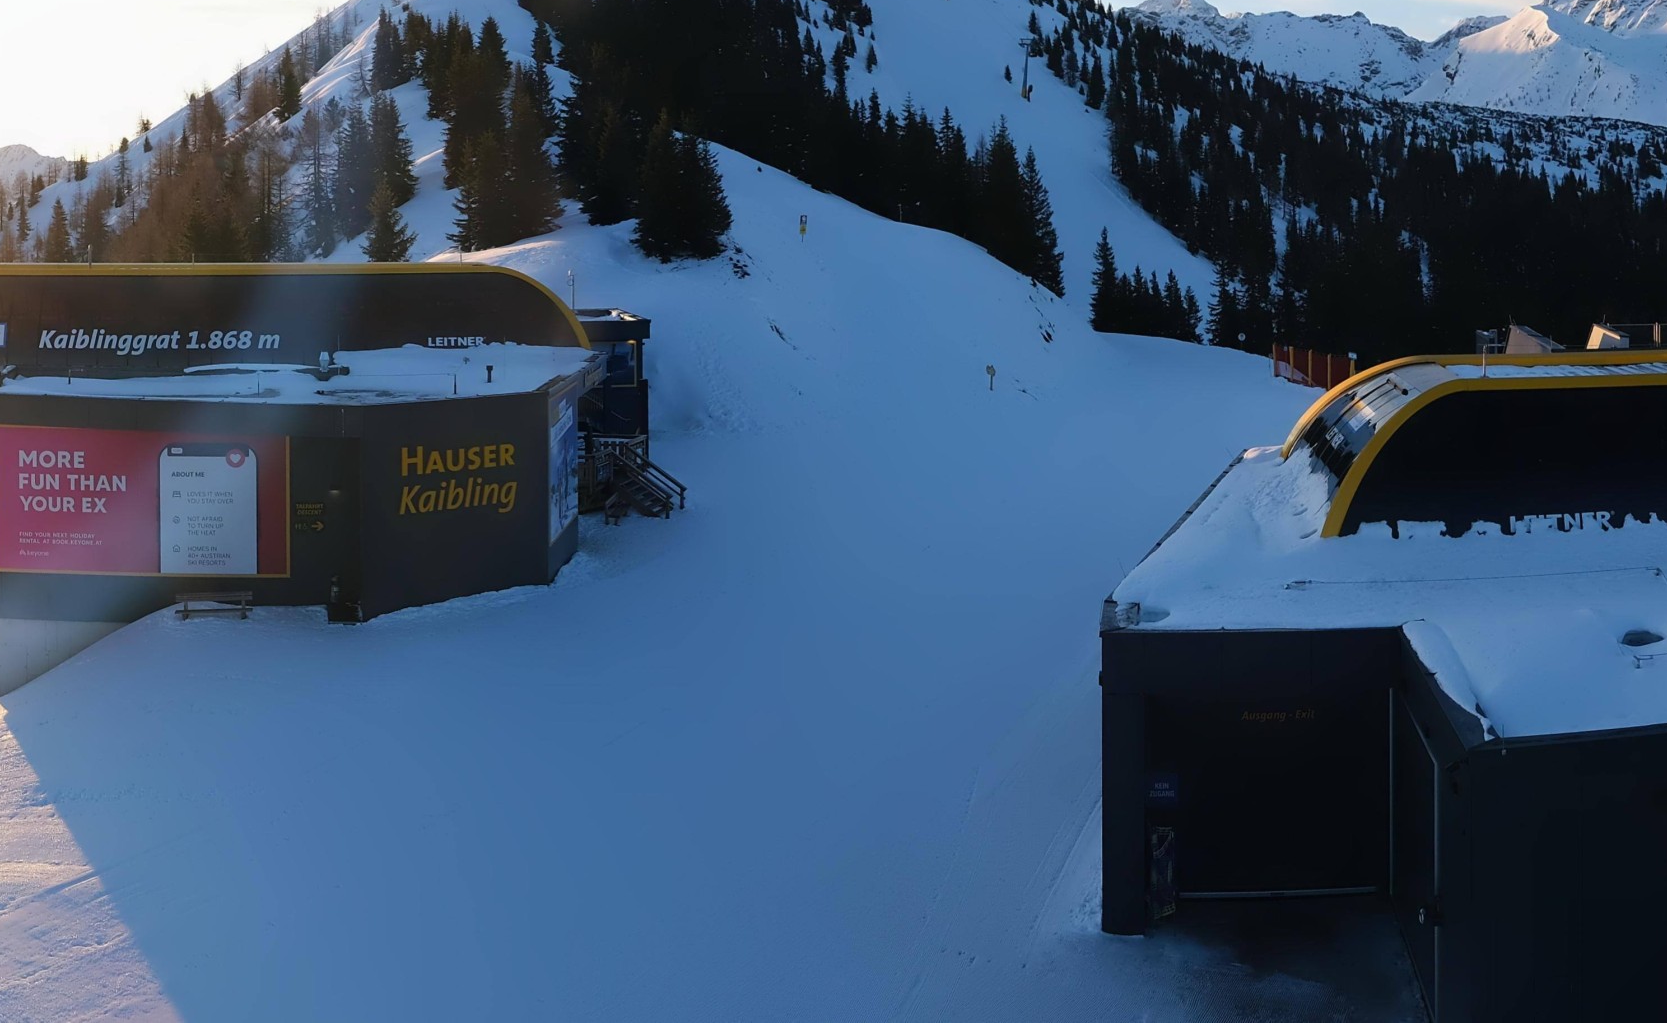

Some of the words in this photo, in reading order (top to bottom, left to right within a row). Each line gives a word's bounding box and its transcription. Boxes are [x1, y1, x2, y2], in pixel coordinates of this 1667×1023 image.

[38, 329, 181, 355] Kaiblinggrat
[186, 330, 253, 350] 1.868
[257, 334, 280, 349] m
[427, 336, 484, 347] LEITNER
[18, 450, 85, 468] MORE
[401, 443, 515, 476] HAUSER
[18, 473, 60, 490] FUN
[67, 474, 127, 492] THAN
[20, 496, 76, 512] YOUR
[81, 497, 107, 513] EX
[399, 477, 518, 515] Kaibling
[1509, 511, 1614, 533] LTNR
[1241, 711, 1287, 722] Ausgang
